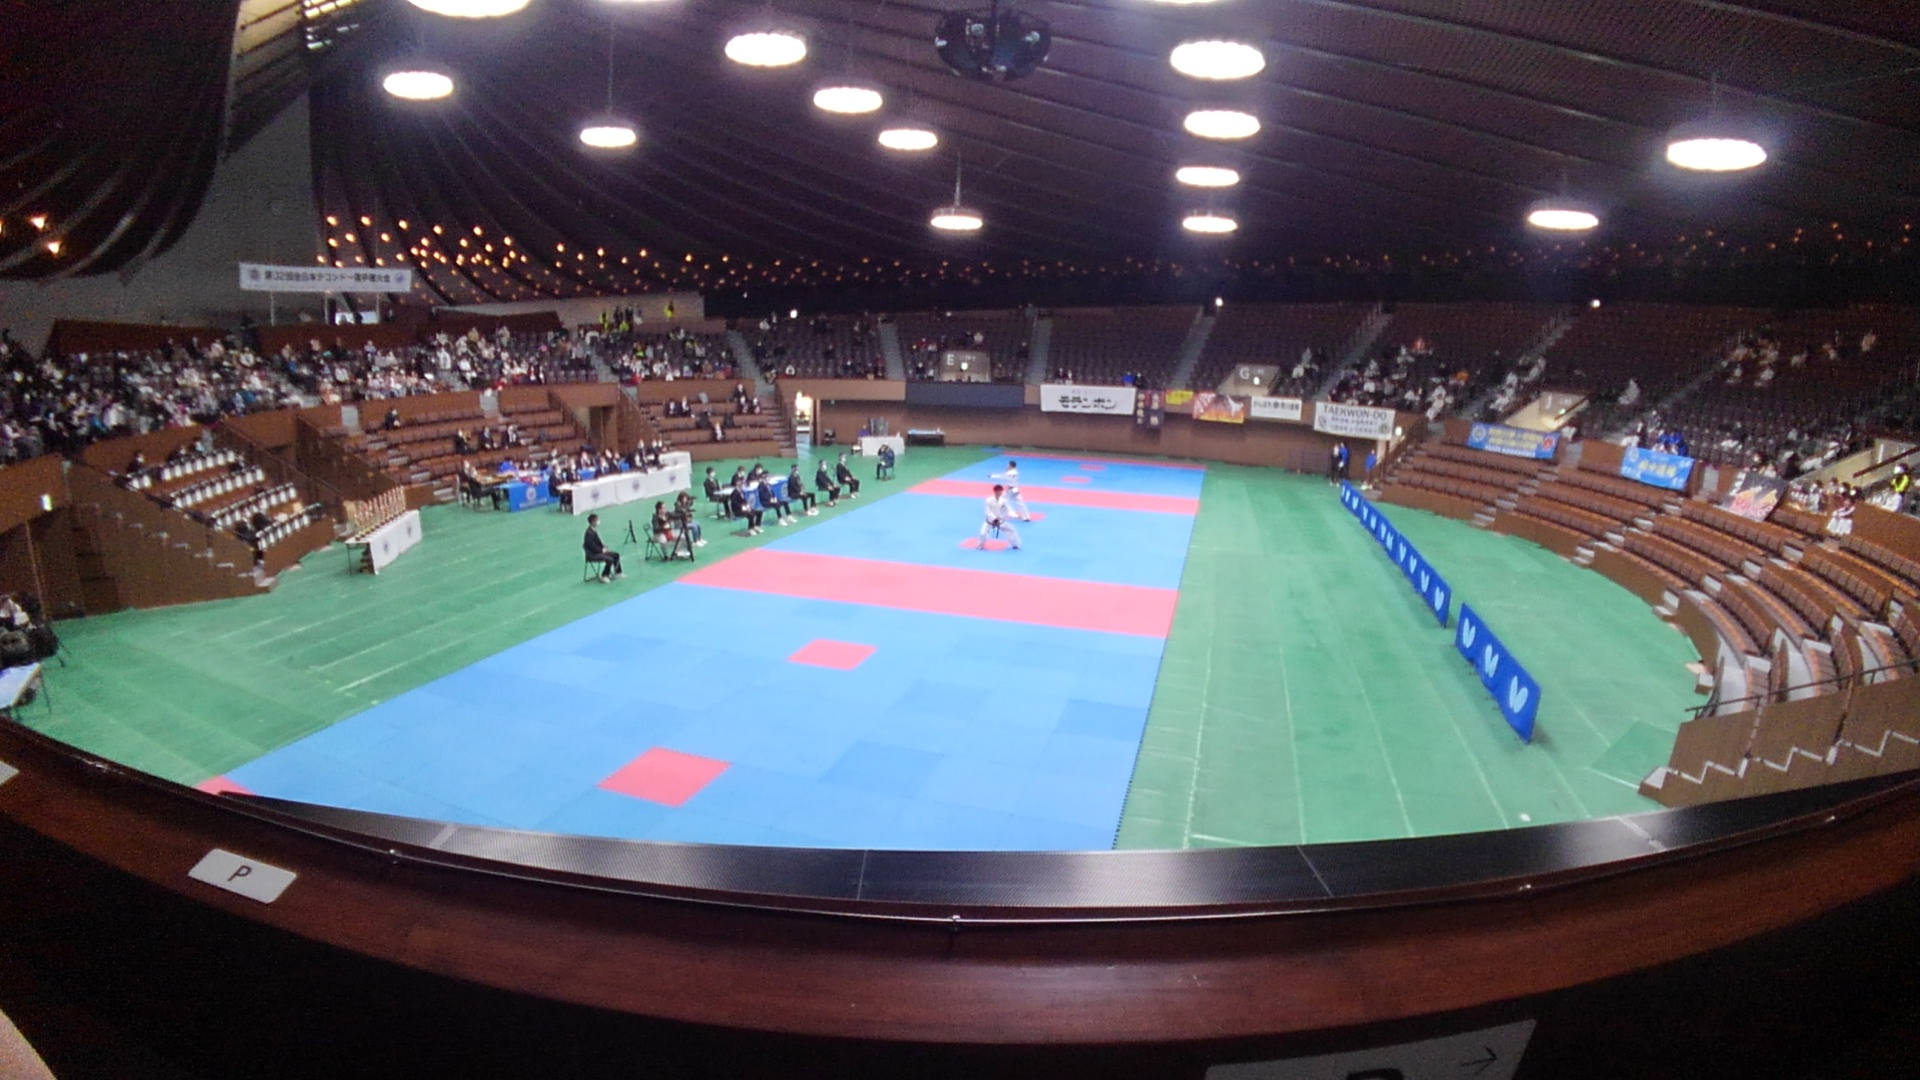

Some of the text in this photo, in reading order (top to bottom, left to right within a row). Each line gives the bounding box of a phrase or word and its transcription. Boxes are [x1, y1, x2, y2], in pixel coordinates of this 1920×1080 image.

[947, 353, 955, 366] E
[1239, 367, 1250, 380] G
[1323, 405, 1387, 421] TAEKWON-DO
[227, 864, 252, 882] P
